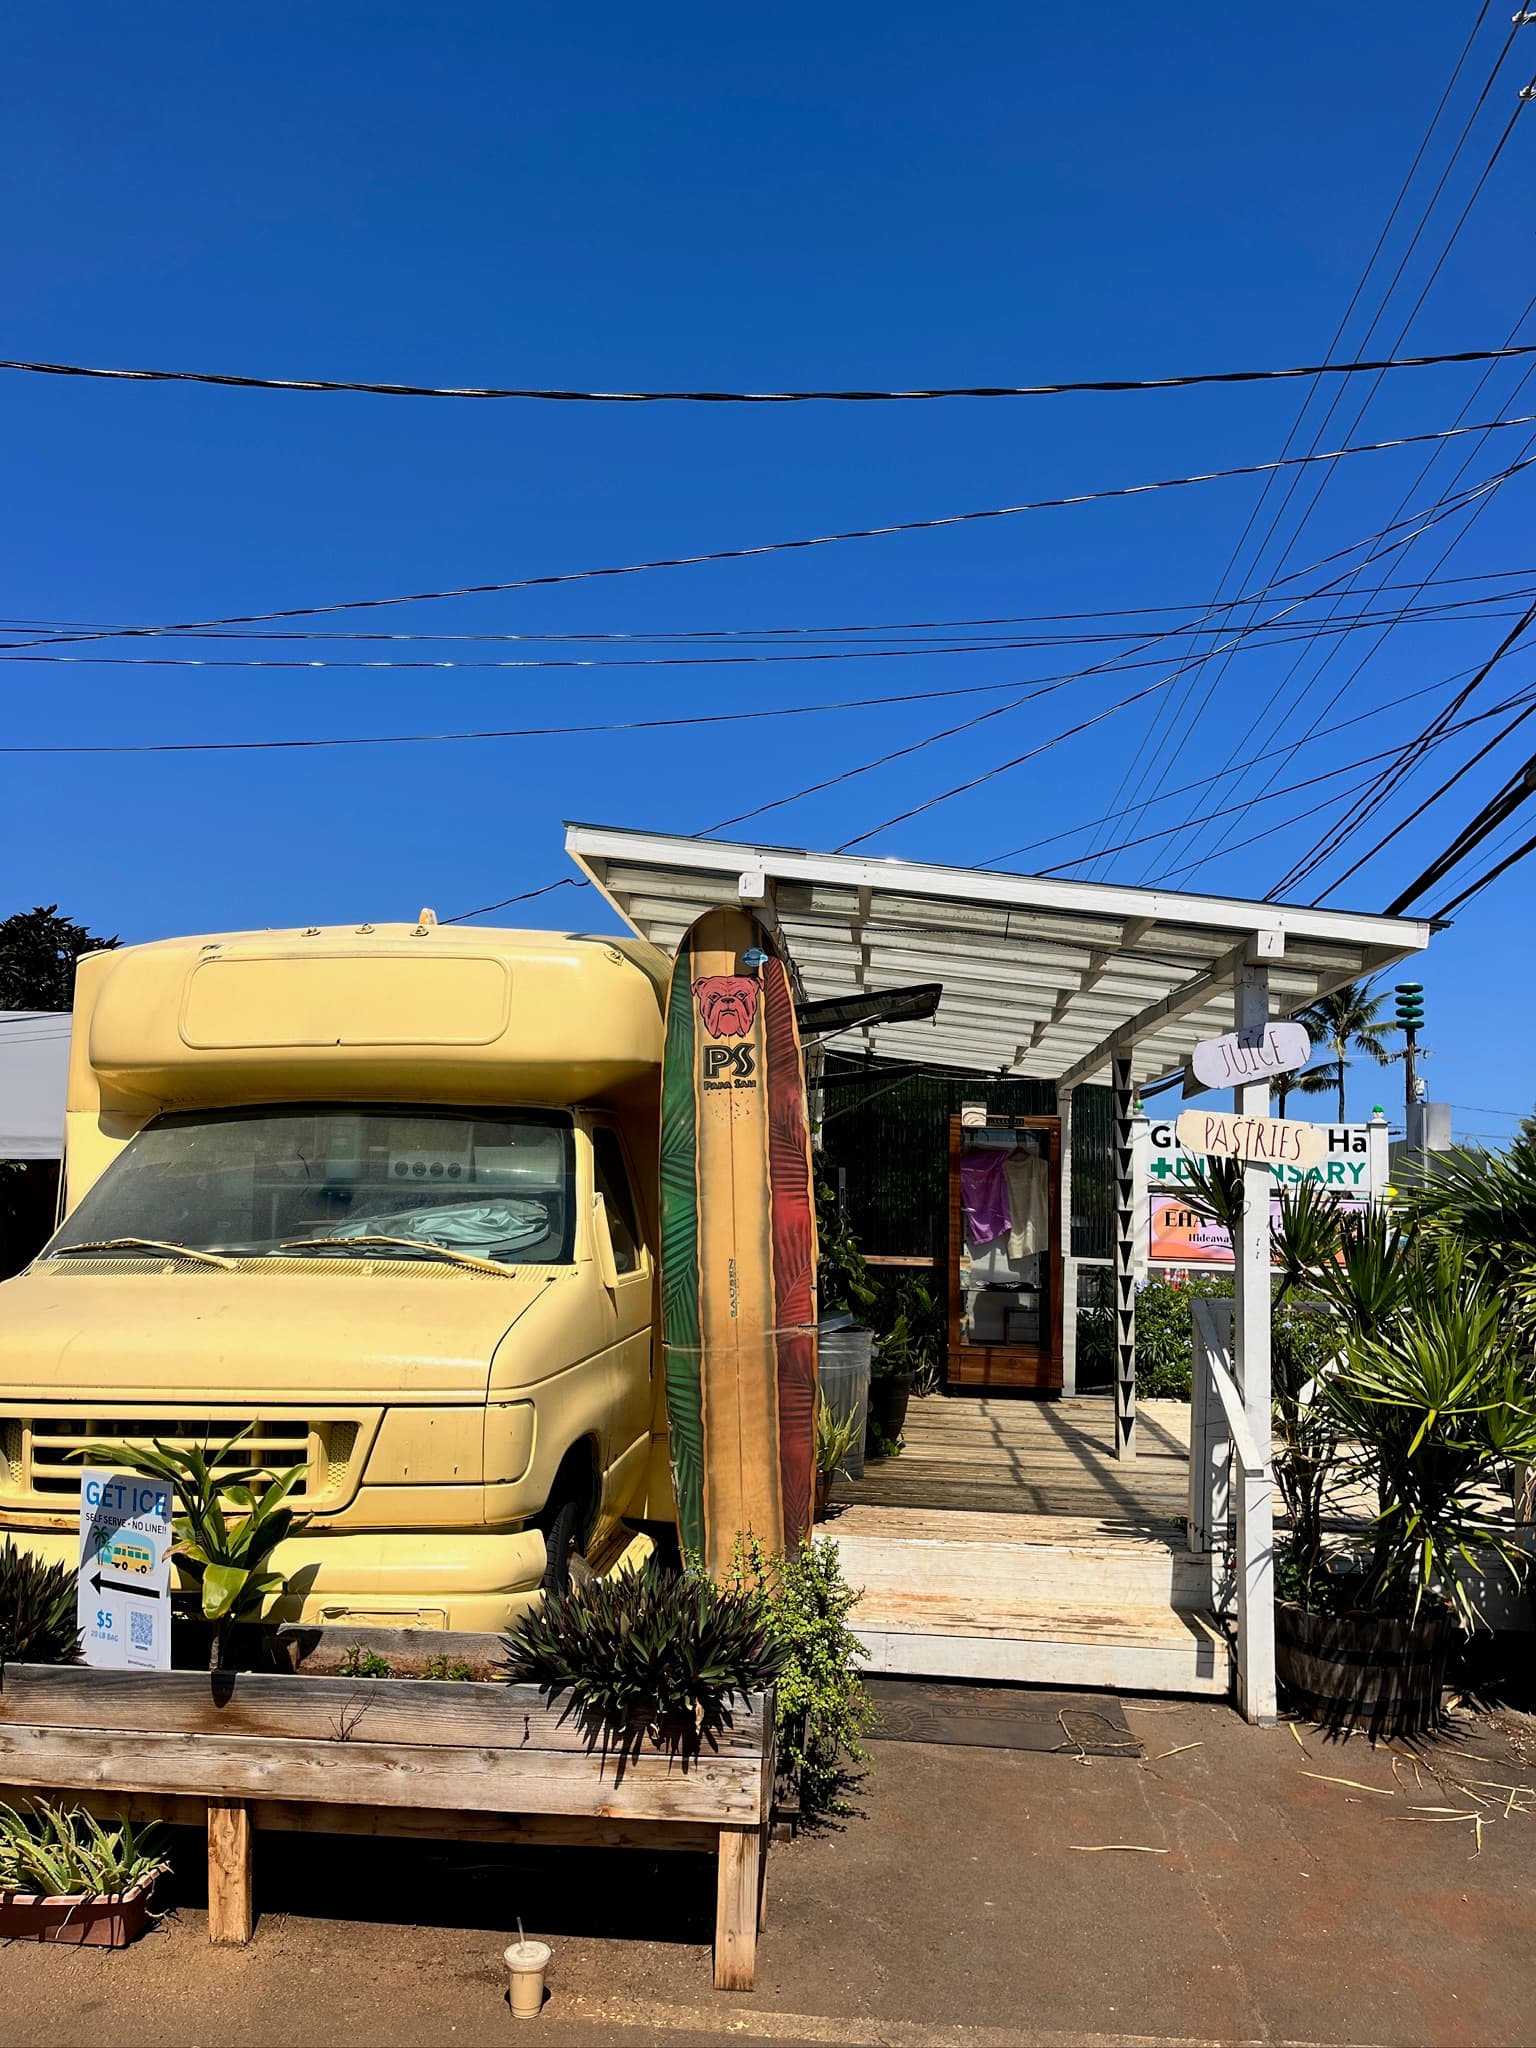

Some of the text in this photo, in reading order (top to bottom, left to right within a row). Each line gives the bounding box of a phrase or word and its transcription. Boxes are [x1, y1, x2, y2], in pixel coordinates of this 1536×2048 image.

[703, 1043, 756, 1079] PS
[1218, 1031, 1285, 1078] JUICE
[1205, 1117, 1303, 1161] PASTRIES
[86, 1481, 168, 1517] GET ICE
[86, 1512, 103, 1523] SELF
[104, 1515, 127, 1528] SERVE
[132, 1520, 144, 1531] NO
[145, 1523, 167, 1534] LINE!!
[96, 1609, 113, 1629] $5
[107, 1633, 118, 1642] BAG
